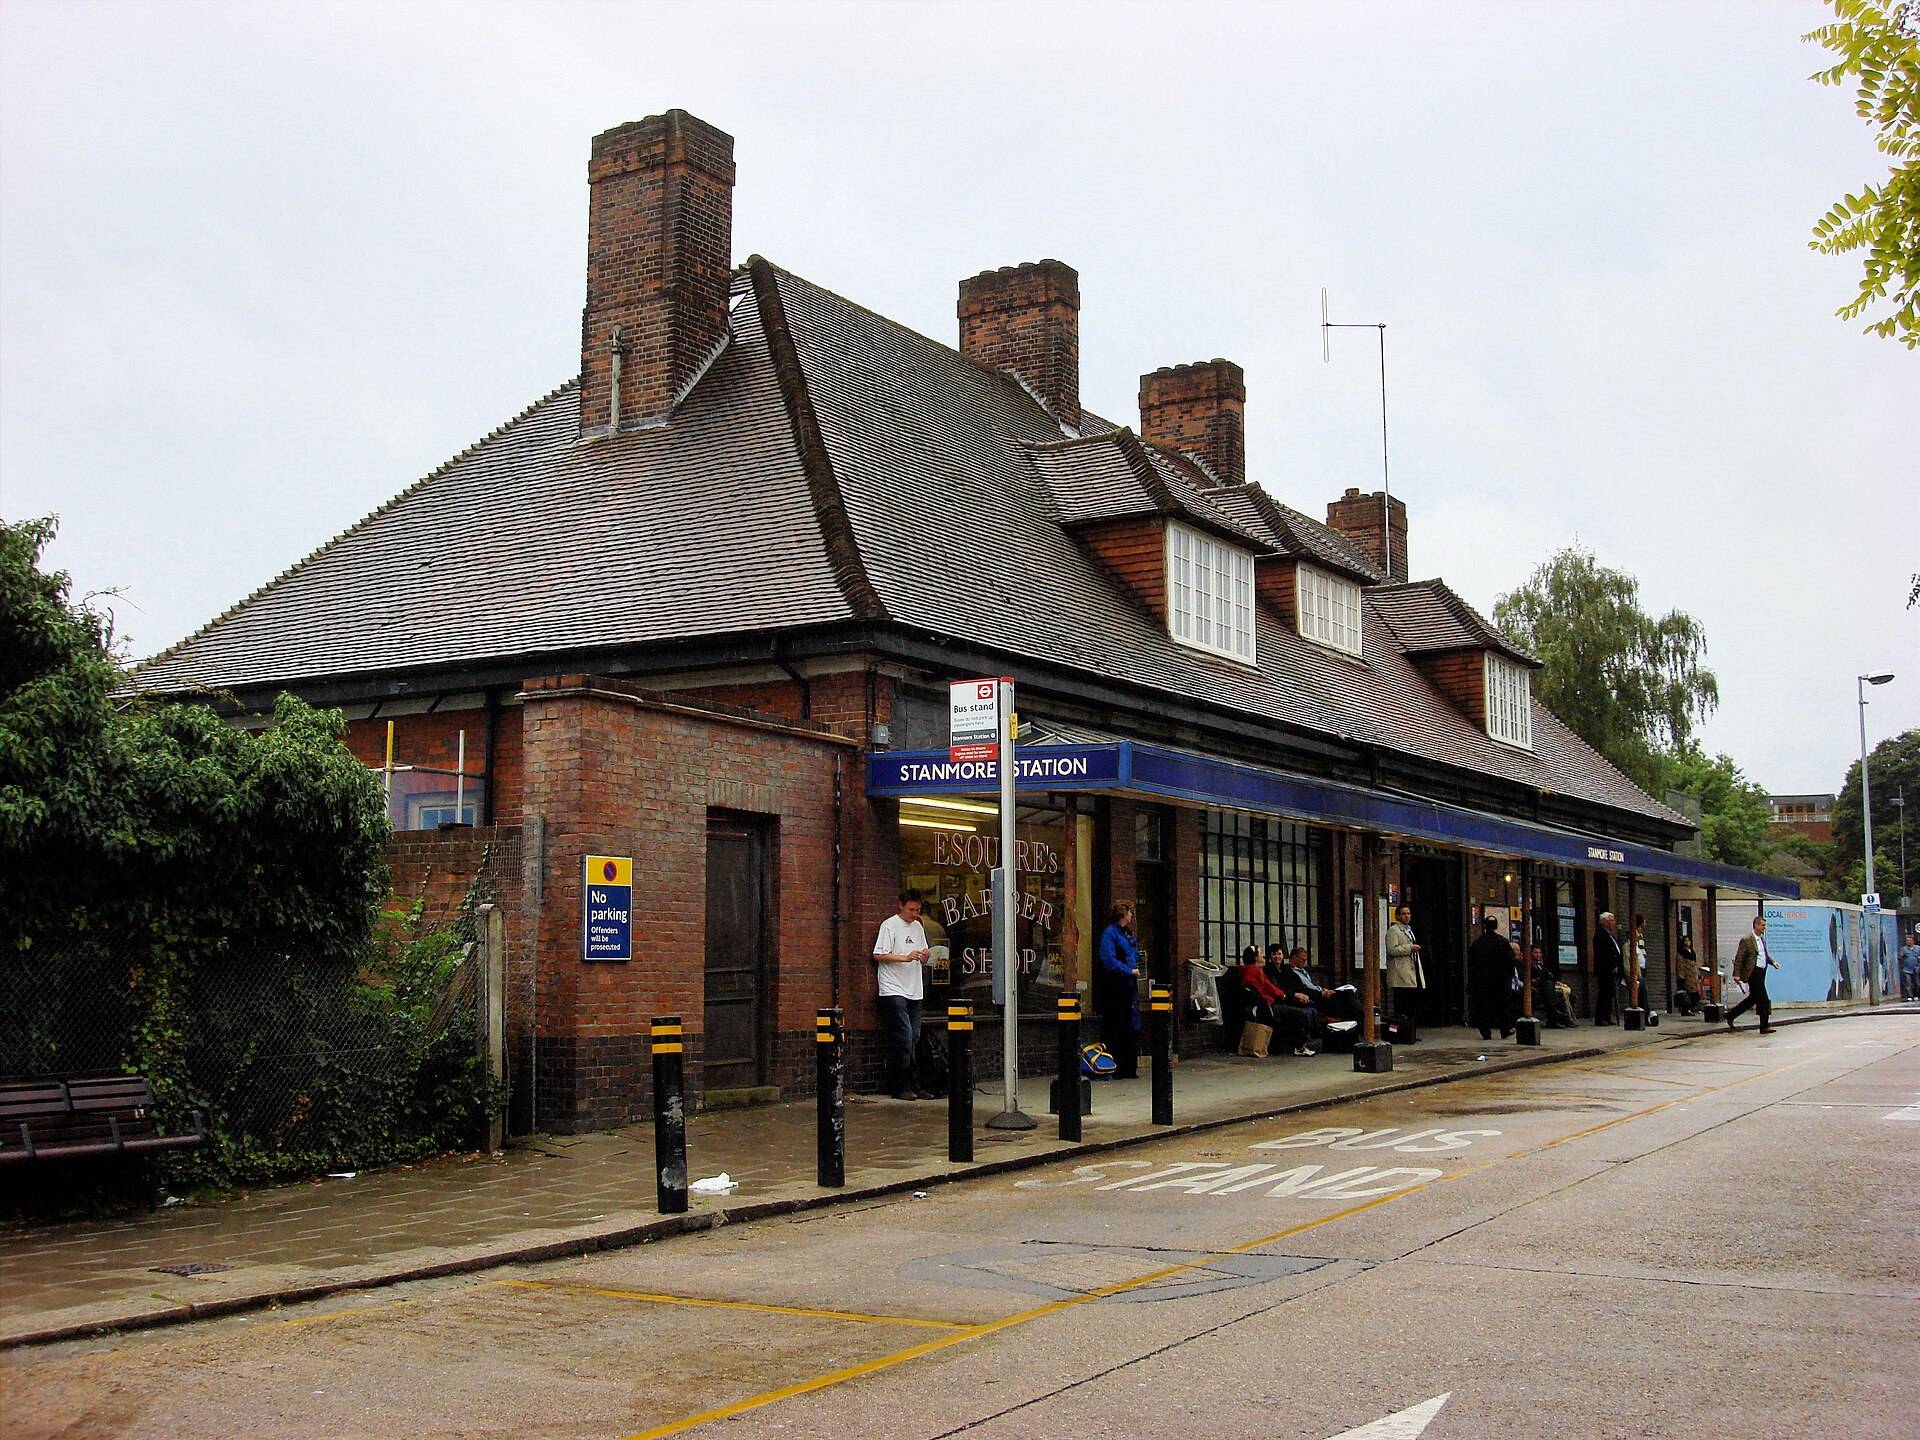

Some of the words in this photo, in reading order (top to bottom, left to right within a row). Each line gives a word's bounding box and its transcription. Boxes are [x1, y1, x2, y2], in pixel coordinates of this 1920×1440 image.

[953, 704, 968, 714] Bus
[970, 701, 994, 712] stand
[900, 761, 997, 781] STANMORE
[1014, 758, 1087, 778] STATION
[933, 831, 1058, 874] ESQURE's
[1587, 847, 1608, 860] STANMORE
[1608, 850, 1625, 862] STATION
[591, 890, 607, 904] No
[591, 907, 627, 924] parking
[941, 888, 1053, 930] BARER
[1764, 910, 1784, 919] LOCAL
[590, 926, 619, 935] Offenders
[590, 935, 601, 943] will
[601, 935, 609, 943] be
[590, 943, 621, 952] prosecuted
[962, 947, 1037, 974] SHP
[1248, 1128, 1502, 1153] BUS
[1014, 1160, 1444, 1200] STAND
